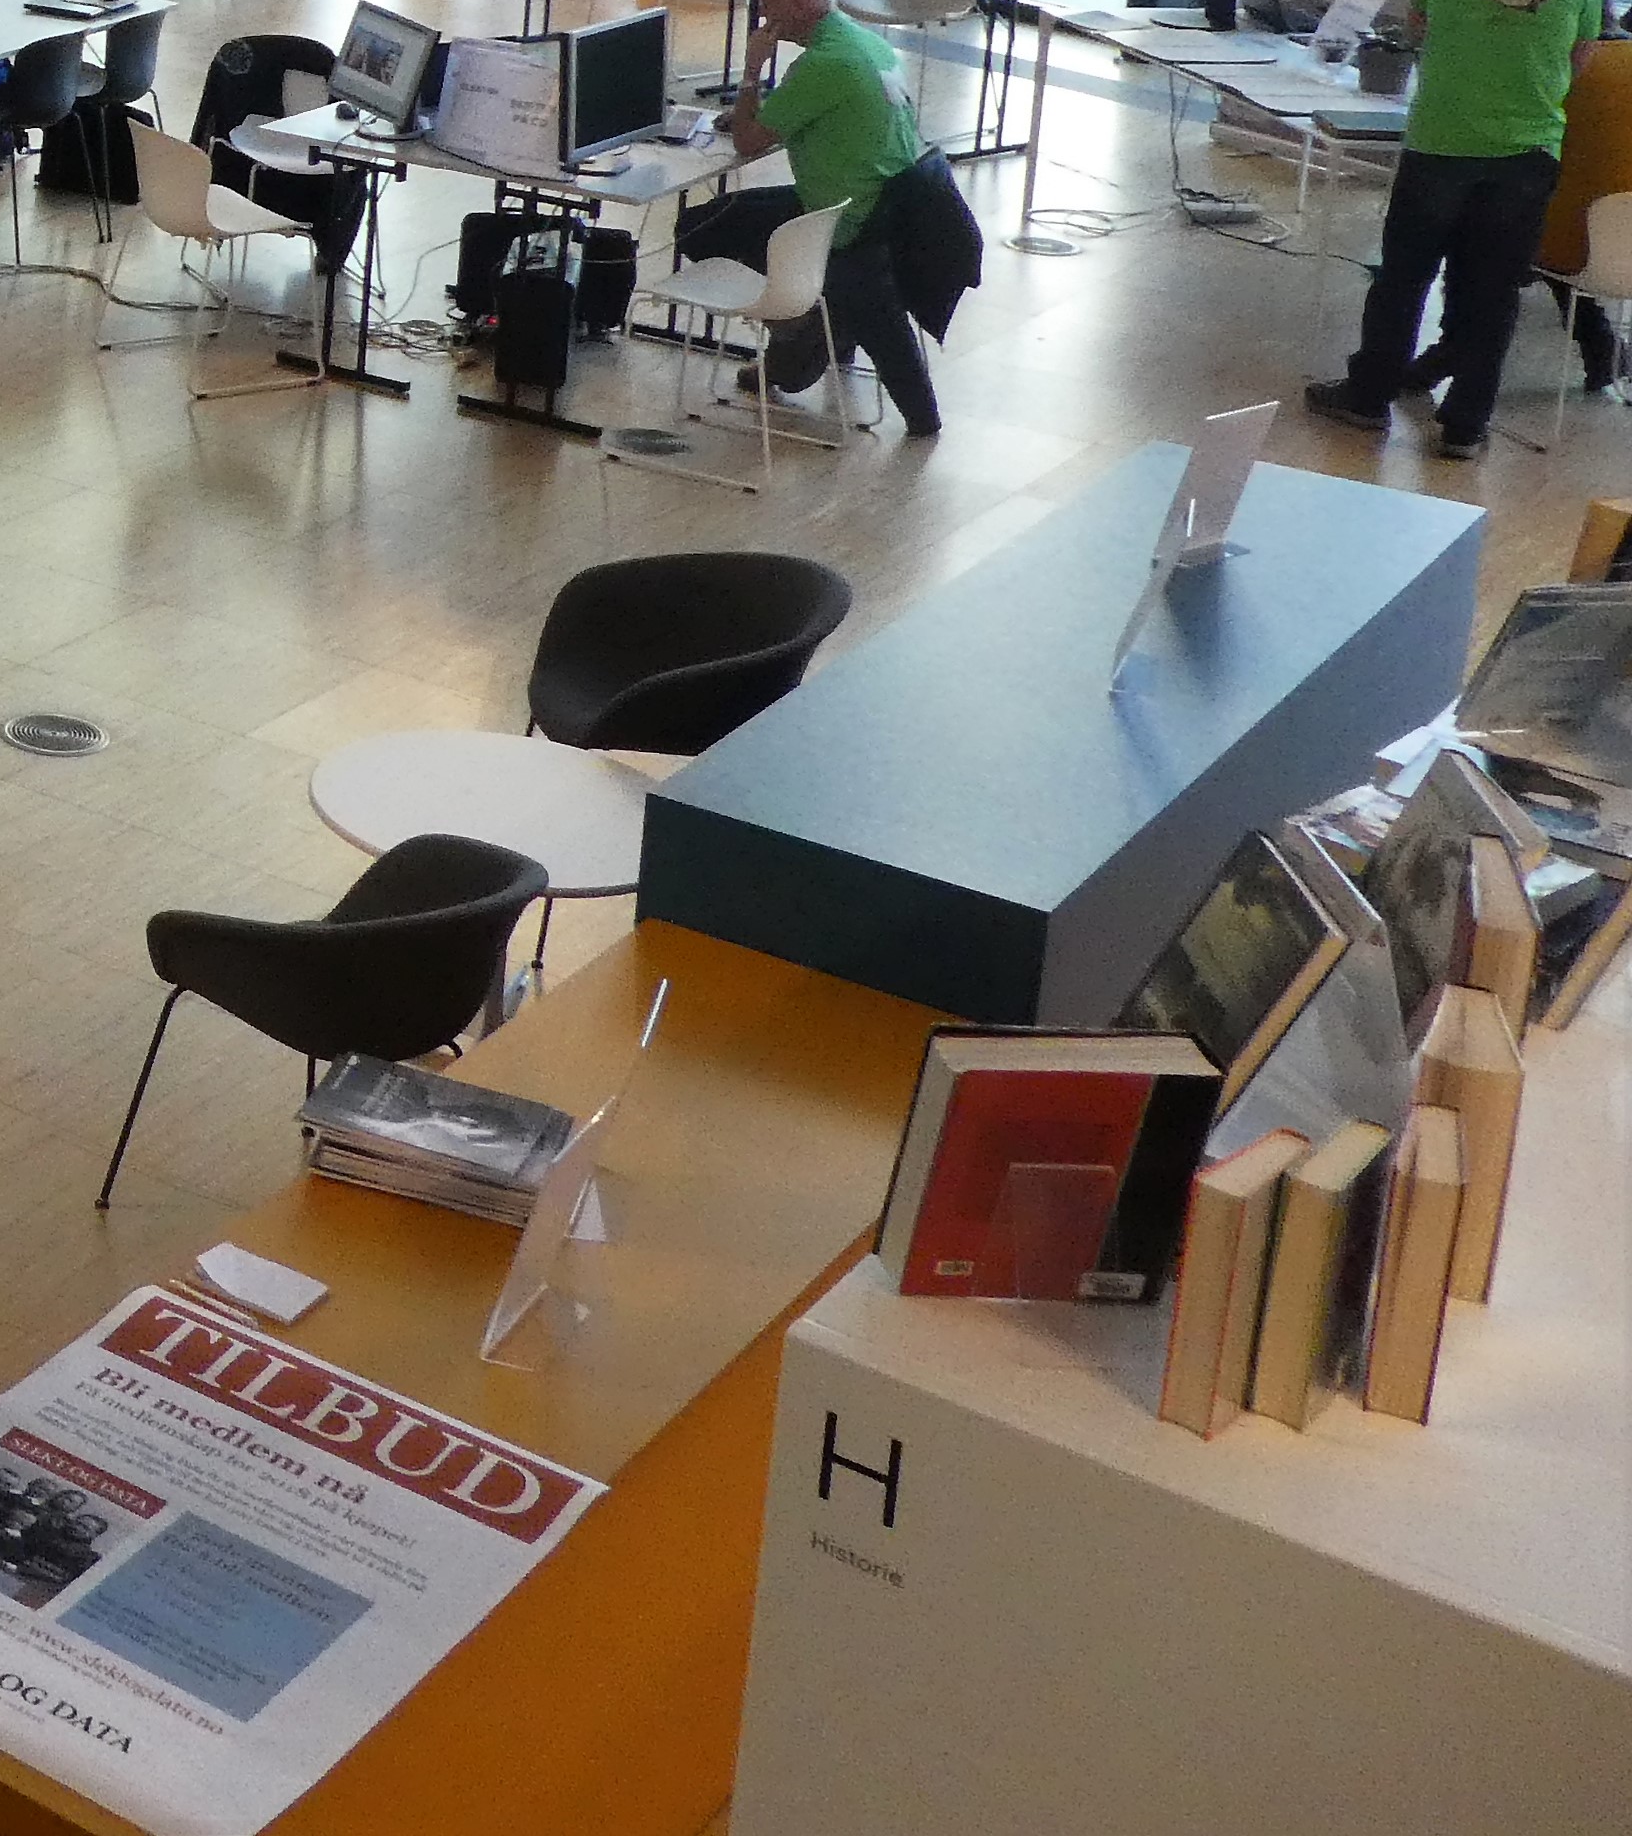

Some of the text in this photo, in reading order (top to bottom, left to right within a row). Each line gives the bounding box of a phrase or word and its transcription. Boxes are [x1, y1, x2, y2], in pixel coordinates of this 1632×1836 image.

[93, 1366, 142, 1401] Bli
[153, 1396, 308, 1479] medlem
[317, 1467, 371, 1505] nå
[139, 1309, 542, 1516] TILBUD
[818, 1411, 903, 1528] H
[809, 1530, 905, 1589] Historie
[51, 1699, 133, 1754] DATA
